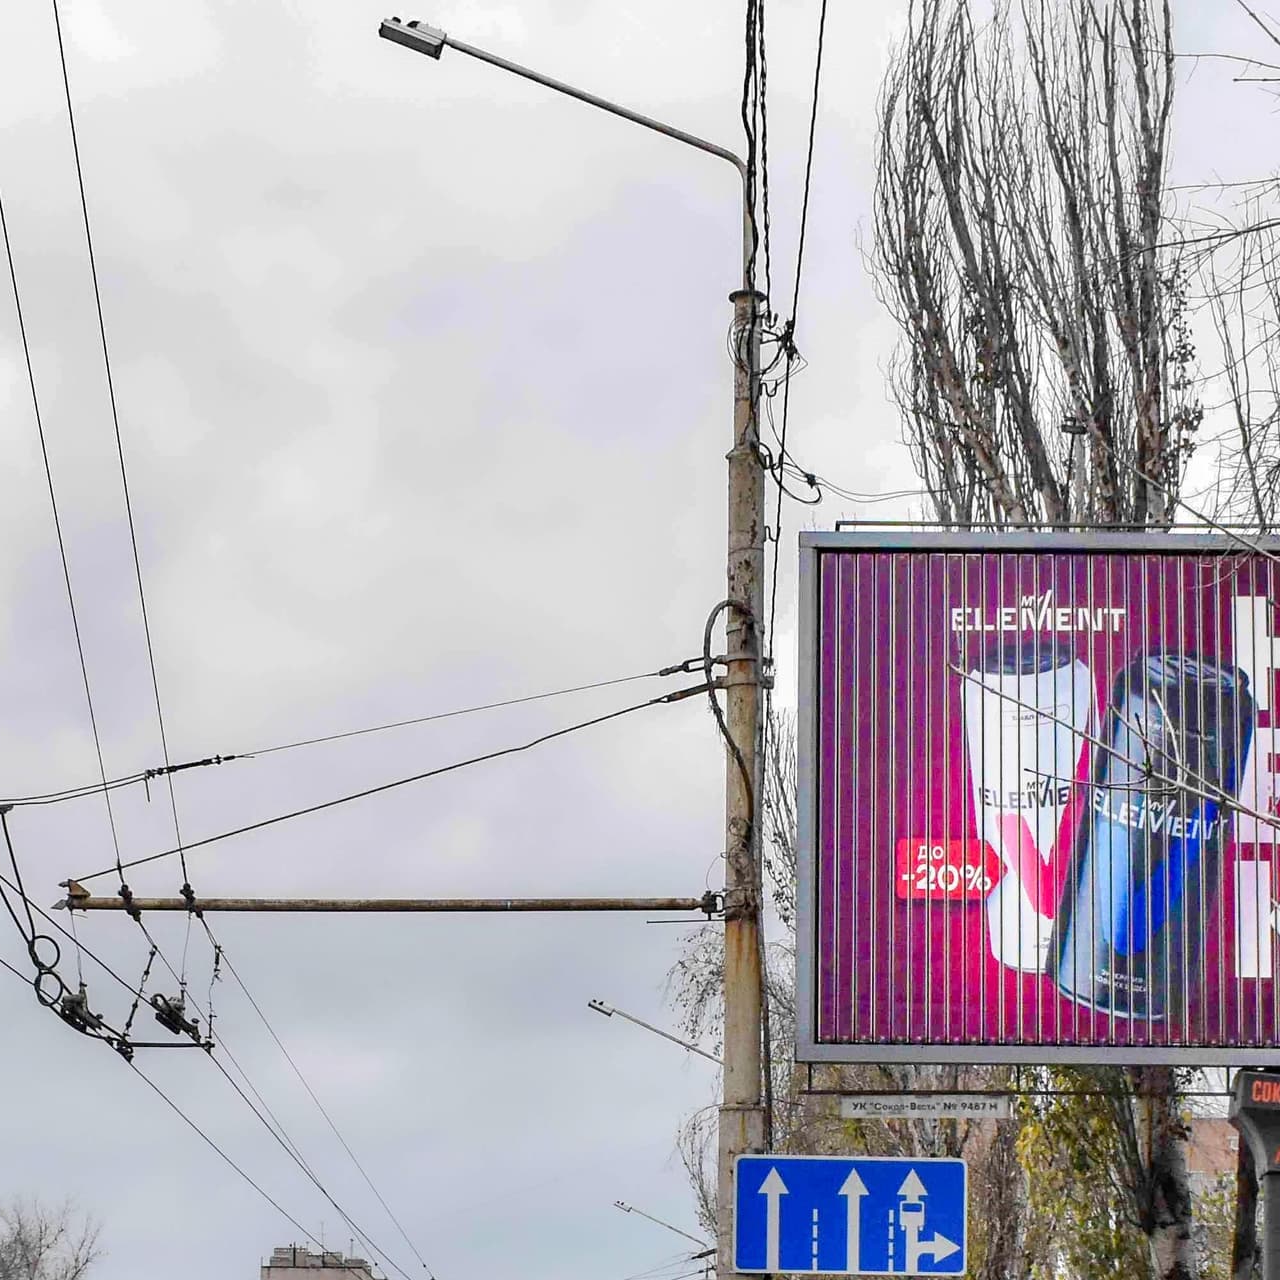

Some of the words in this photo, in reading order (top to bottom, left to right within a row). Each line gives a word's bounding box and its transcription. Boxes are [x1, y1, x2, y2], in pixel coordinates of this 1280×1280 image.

[951, 590, 1127, 633] ELEMENT
[1089, 789, 1229, 840] ELEMENT
[902, 864, 992, 891] -20%
[852, 1102, 868, 1112] УК
